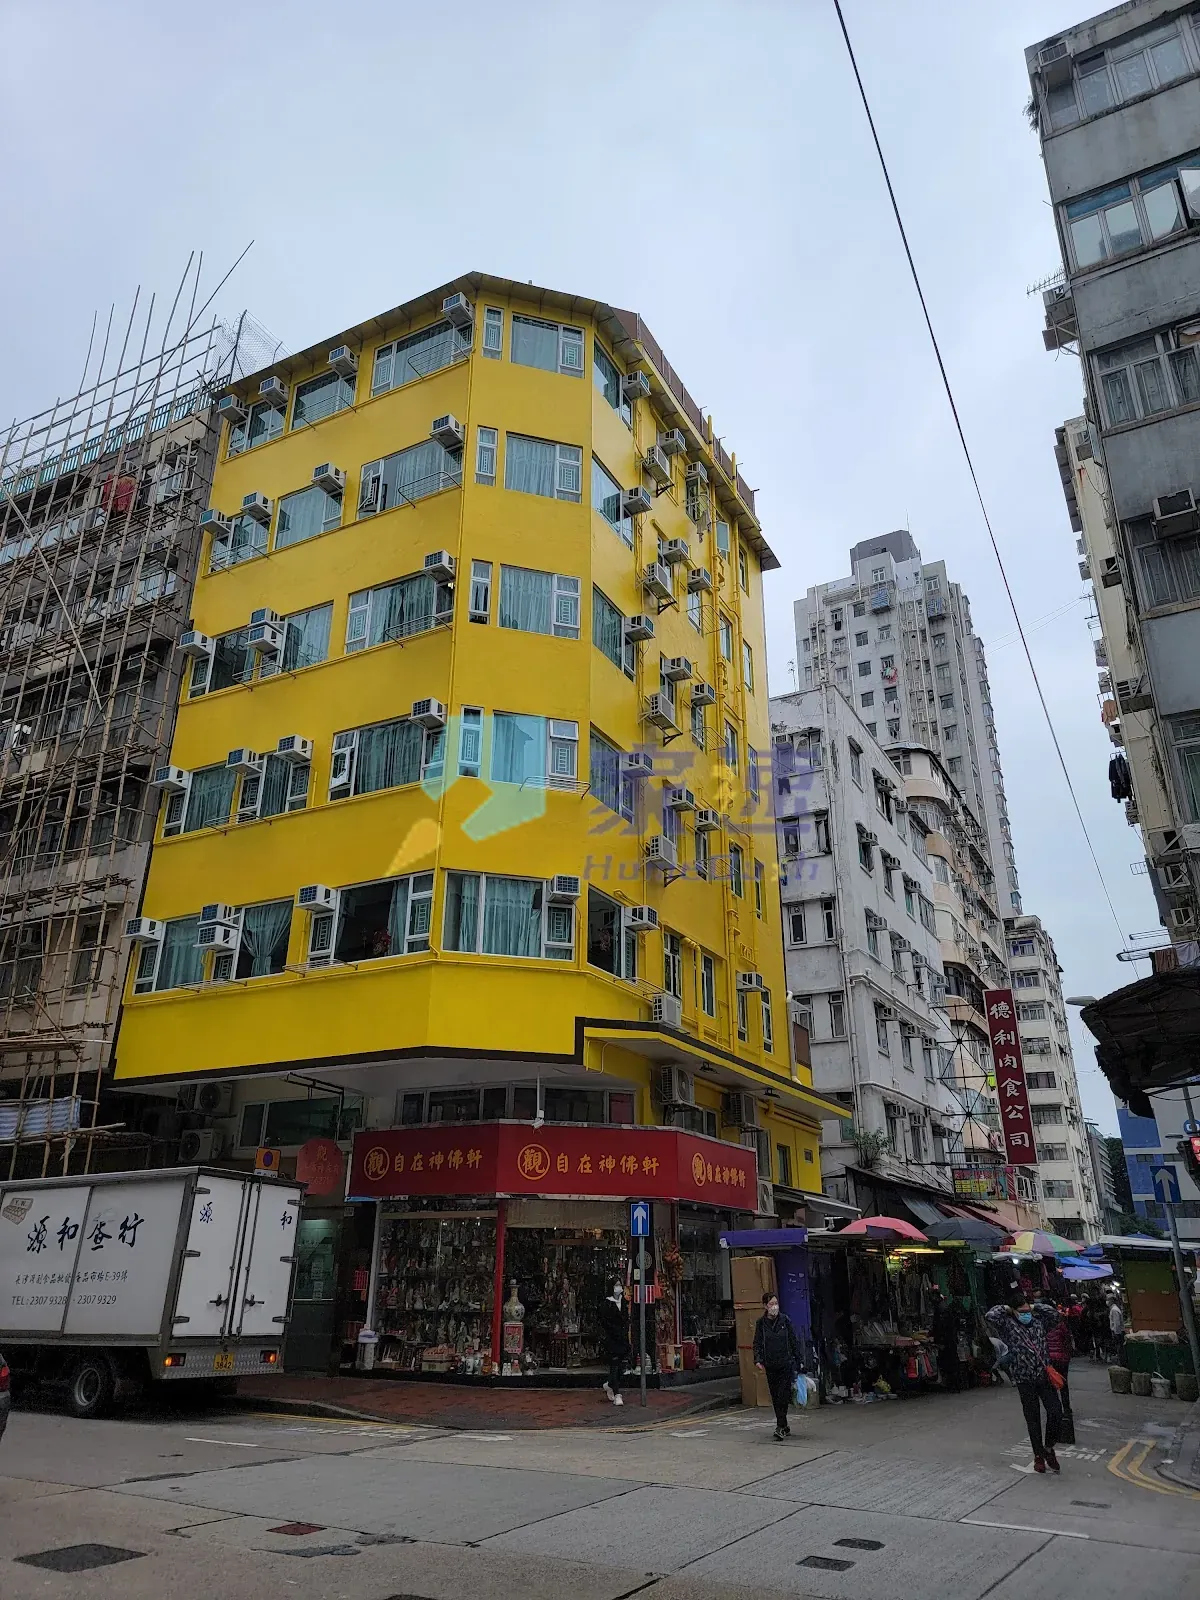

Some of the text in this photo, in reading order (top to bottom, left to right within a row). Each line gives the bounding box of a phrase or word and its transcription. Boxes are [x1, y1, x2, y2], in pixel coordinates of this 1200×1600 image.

[989, 1000, 1031, 1148] 德利肉食公司
[279, 1210, 293, 1231] 和
[214, 1360, 232, 1370] 3842
